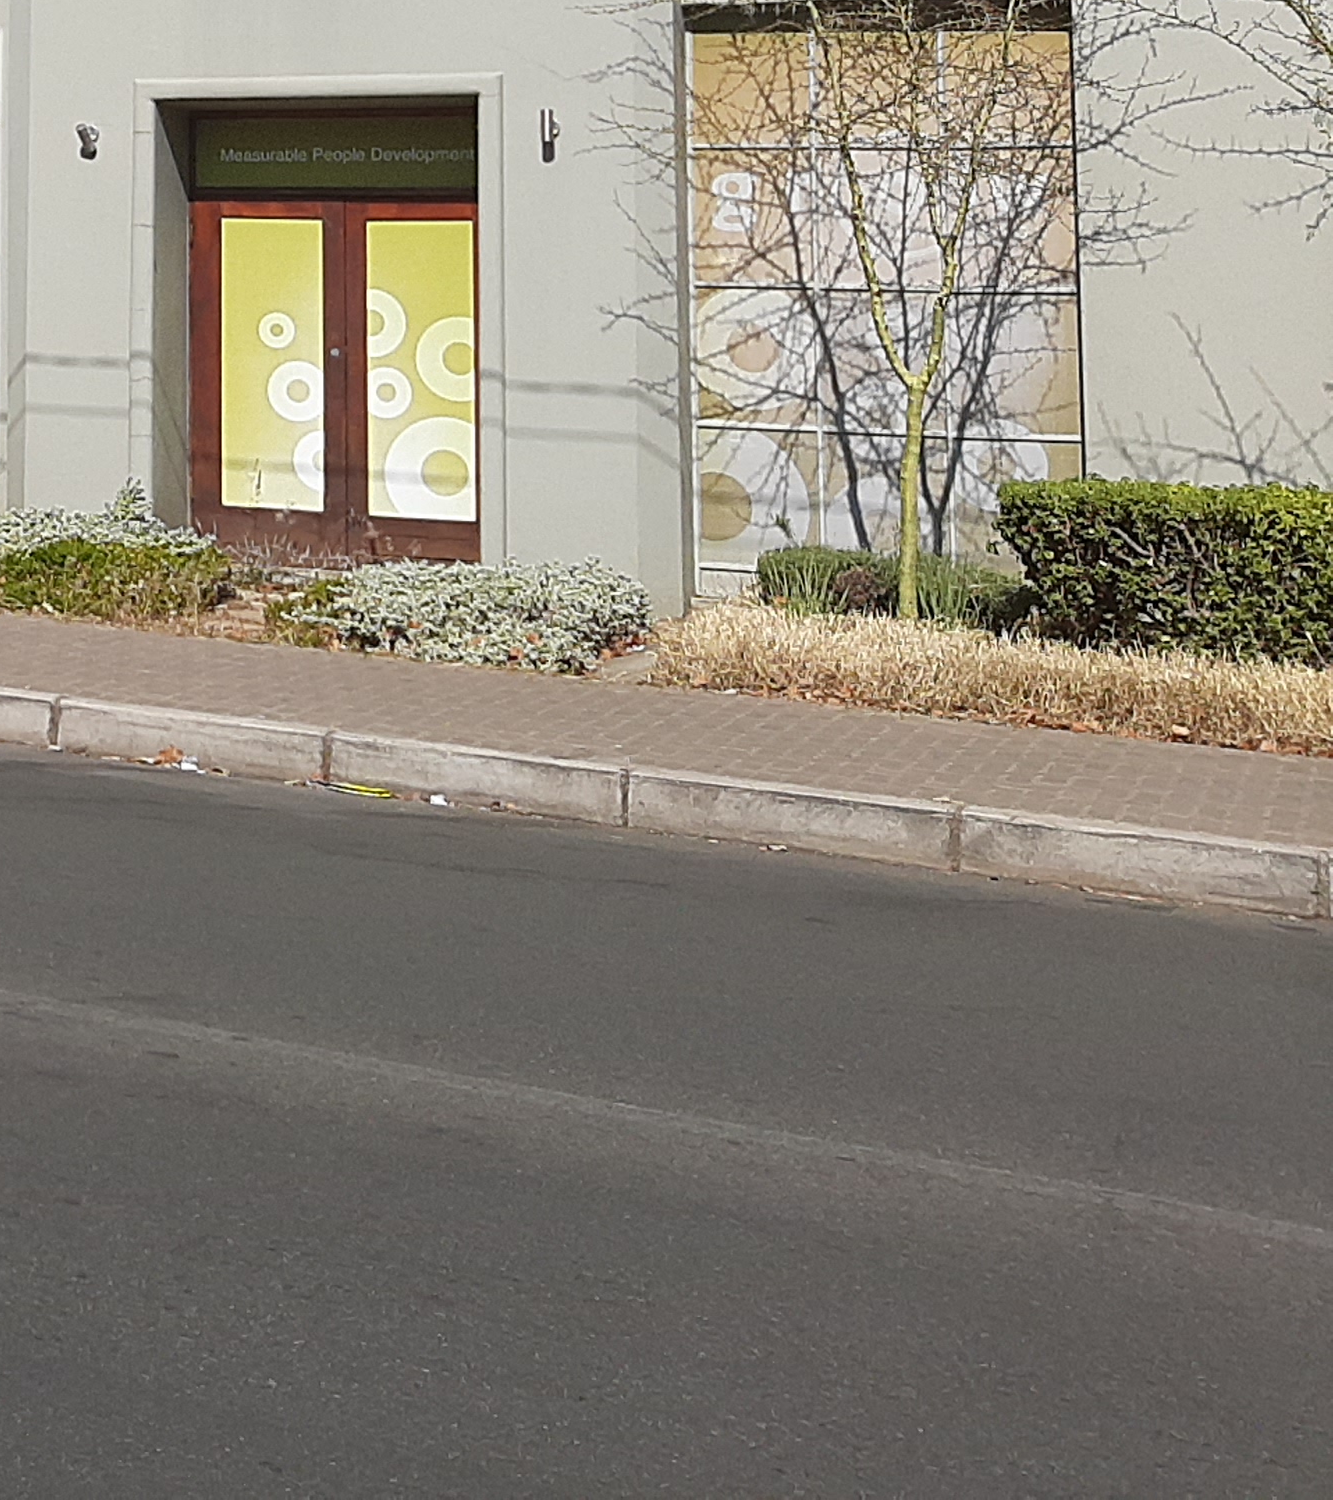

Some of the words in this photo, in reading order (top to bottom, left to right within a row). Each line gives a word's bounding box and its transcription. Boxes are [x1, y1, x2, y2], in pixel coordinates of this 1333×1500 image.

[220, 148, 308, 163] Measurable
[312, 147, 366, 164] People
[370, 147, 475, 164] Development
